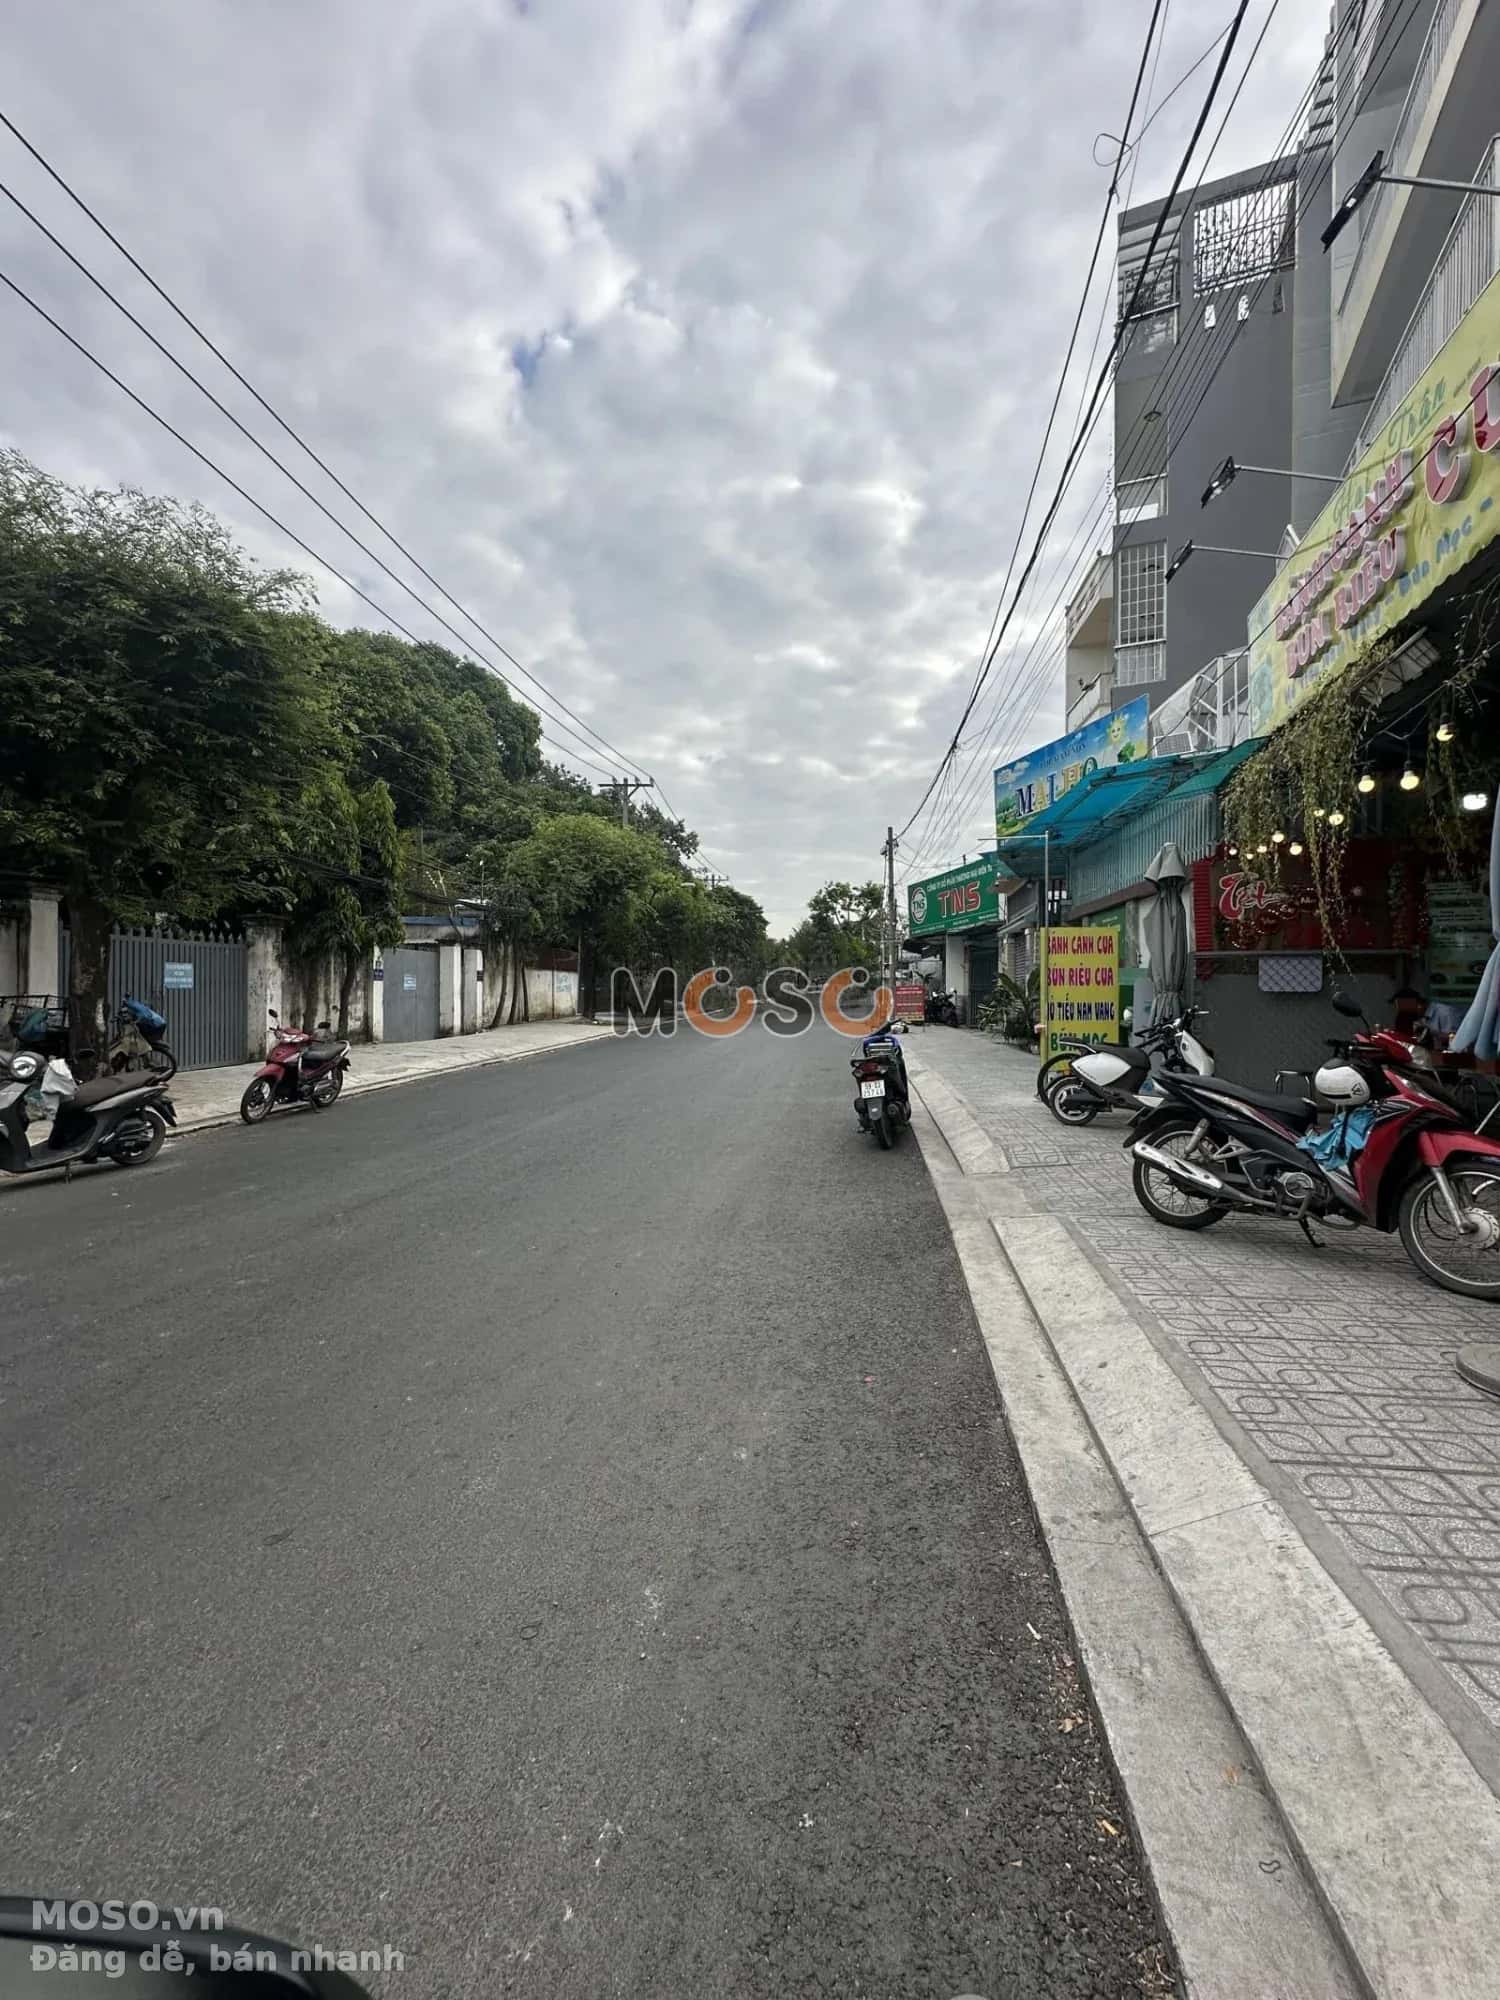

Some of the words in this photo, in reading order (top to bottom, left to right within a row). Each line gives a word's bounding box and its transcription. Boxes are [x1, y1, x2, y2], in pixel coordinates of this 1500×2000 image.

[1334, 526, 1404, 632] RIÊU
[938, 881, 981, 918] TNS
[1071, 936, 1094, 954] CANH
[1097, 936, 1114, 954] CUA
[1095, 967, 1114, 986] CUA
[1077, 1002, 1092, 1020] NAM
[1095, 1002, 1115, 1020] VANG
